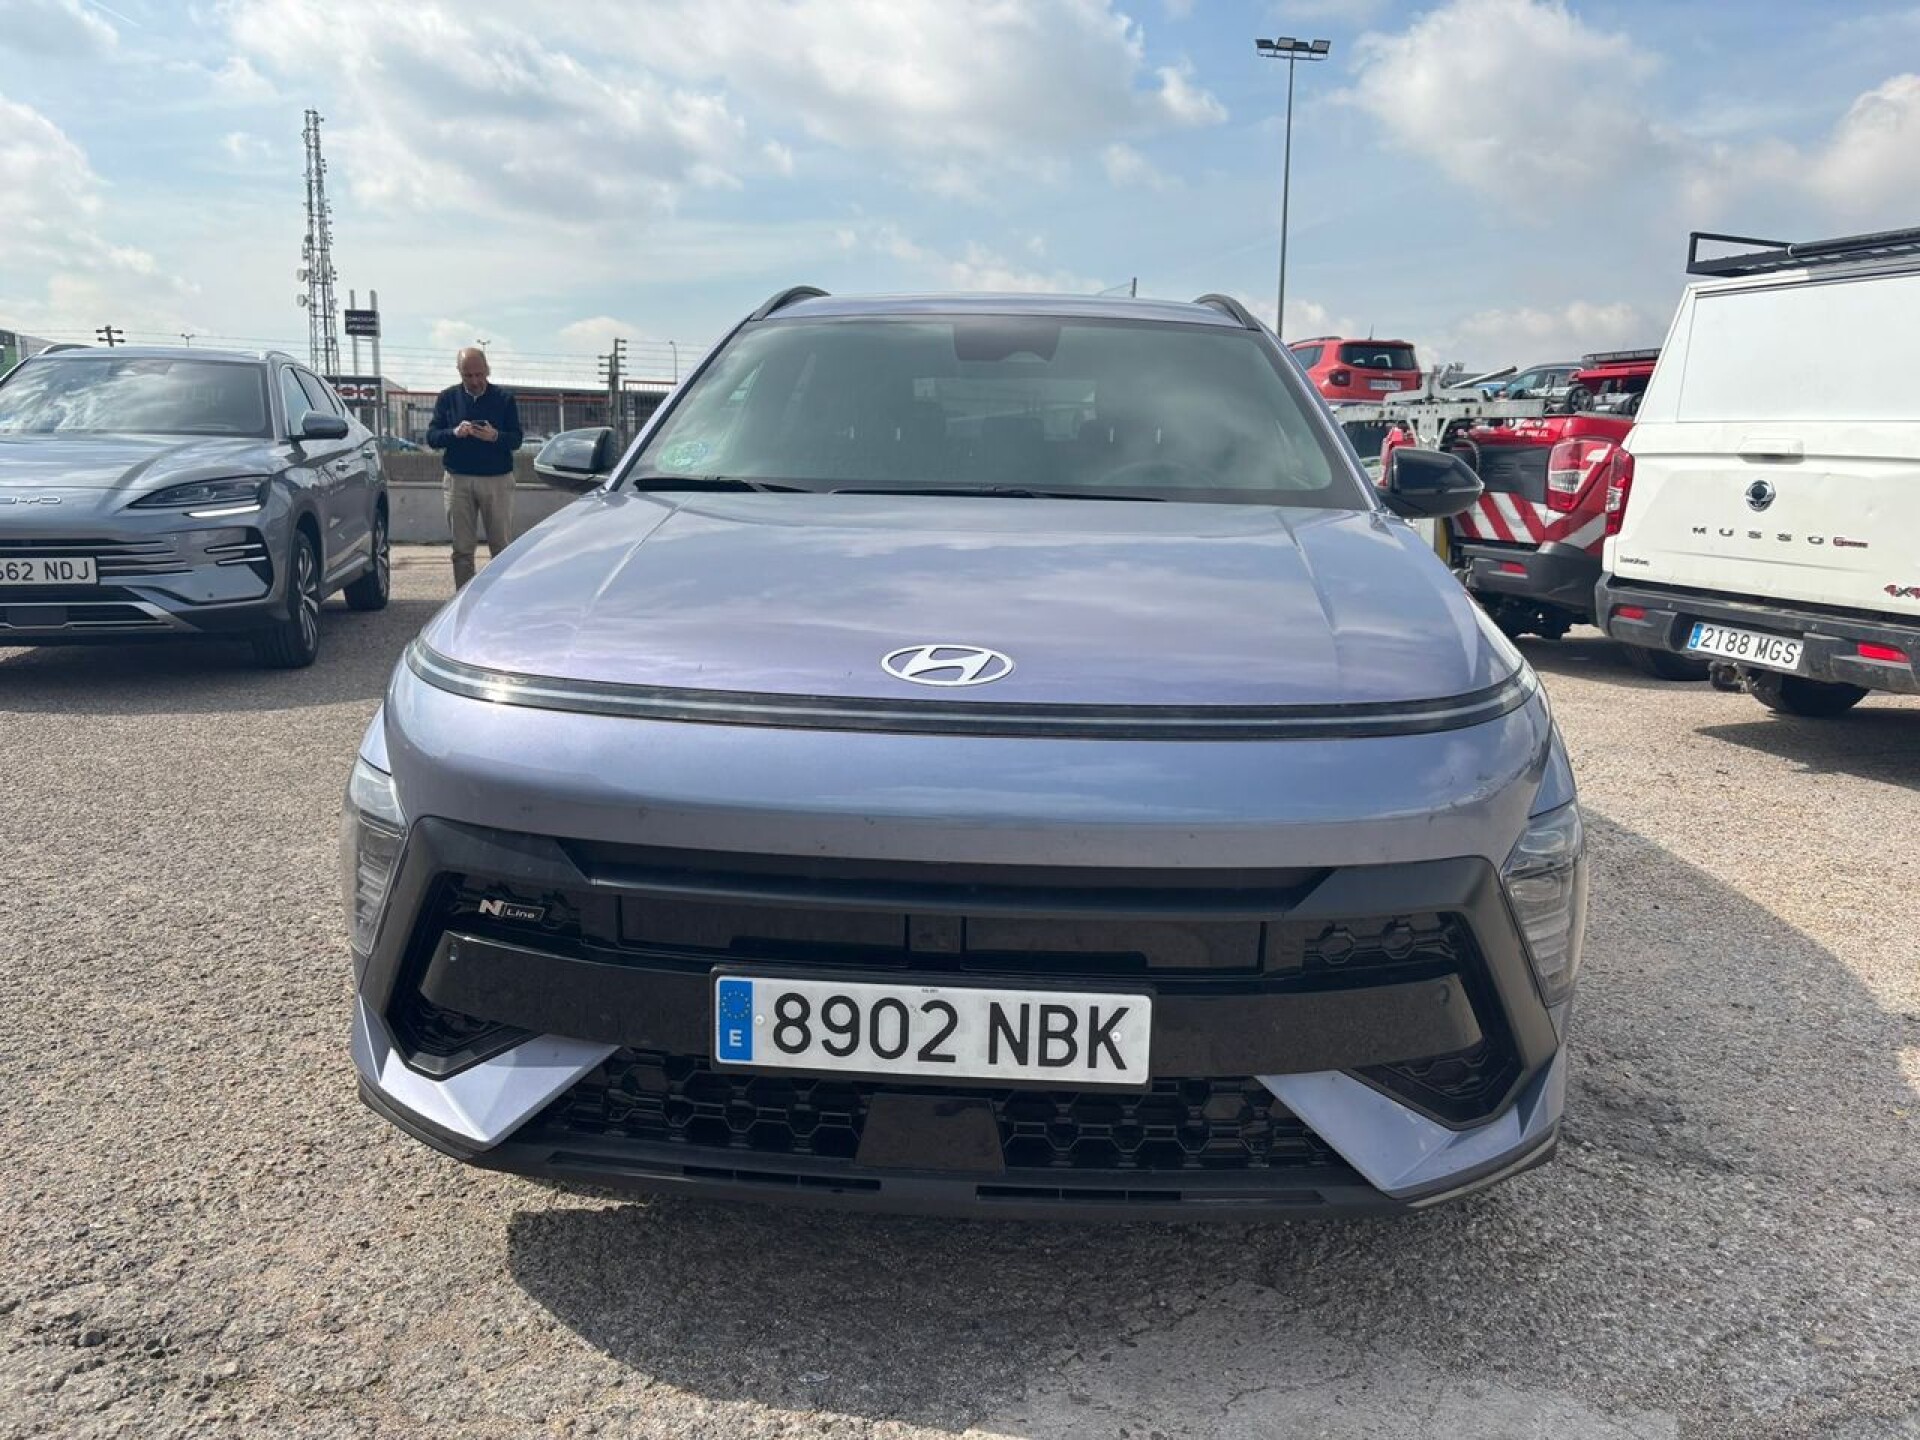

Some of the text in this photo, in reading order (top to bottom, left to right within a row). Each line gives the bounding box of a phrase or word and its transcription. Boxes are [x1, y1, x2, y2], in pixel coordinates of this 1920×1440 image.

[1692, 526, 1824, 546] MUSSO
[44, 561, 89, 580] NDJ
[1700, 627, 1750, 655] 2188
[1754, 637, 1796, 664] MGS
[479, 899, 504, 916] N
[729, 992, 1130, 1070] E 8902 NBK
